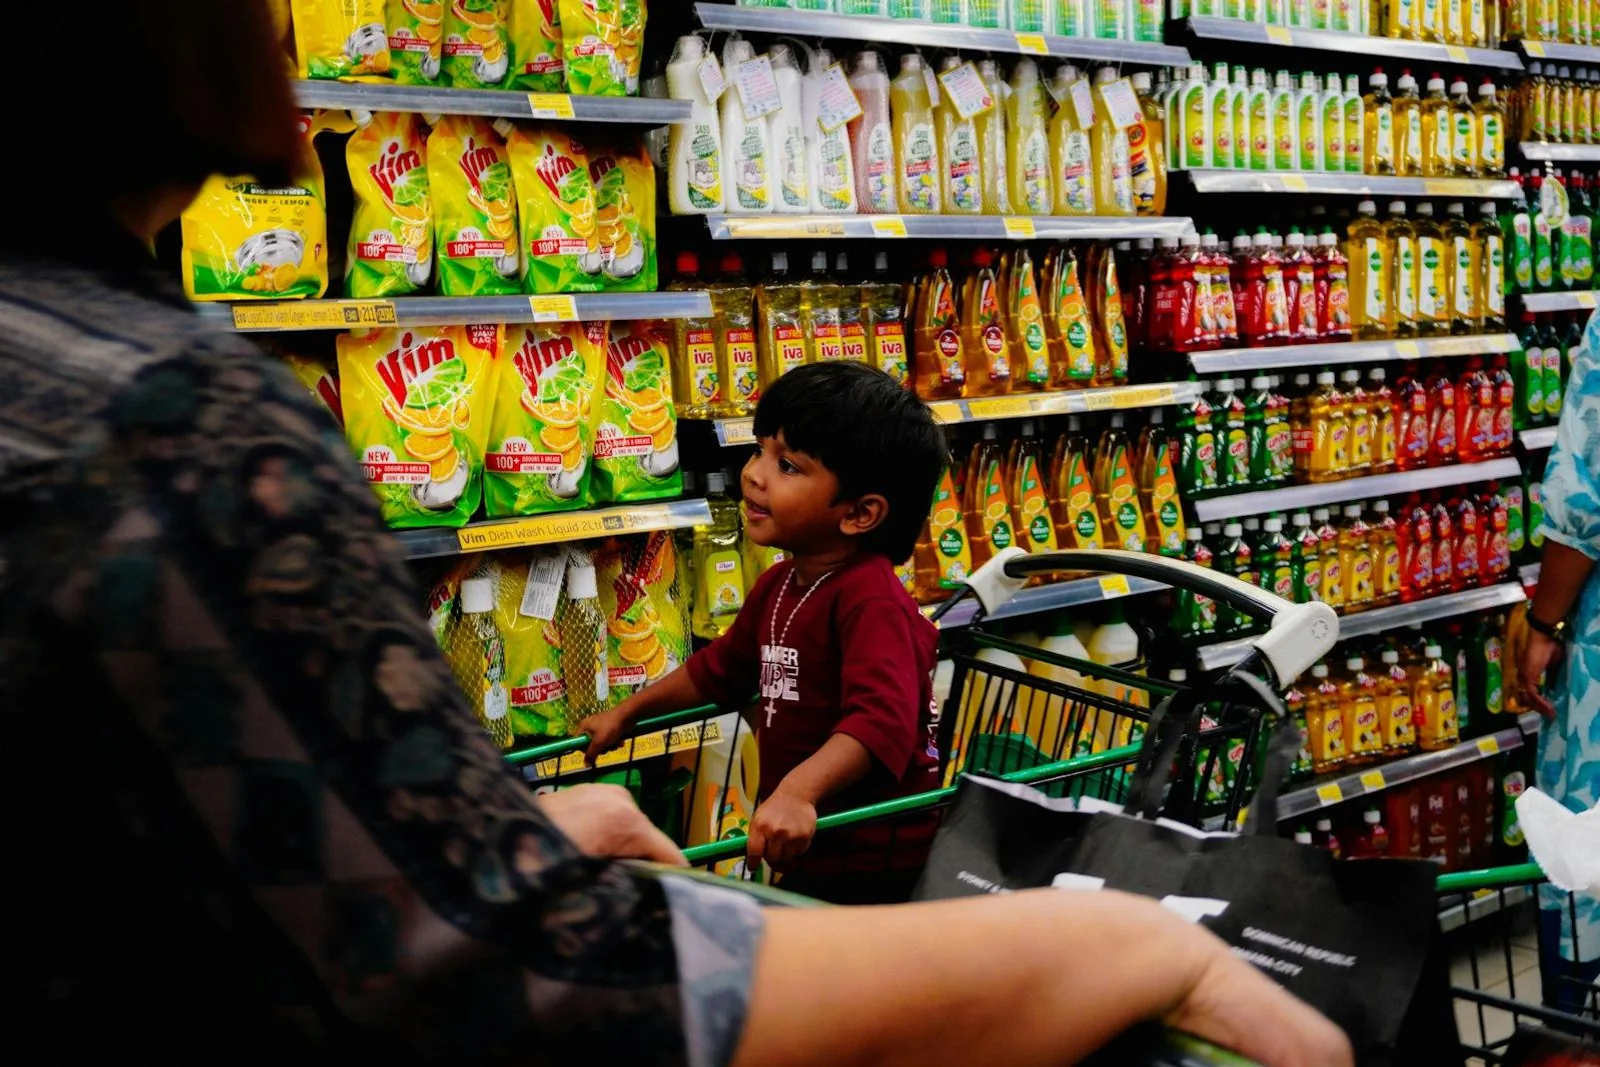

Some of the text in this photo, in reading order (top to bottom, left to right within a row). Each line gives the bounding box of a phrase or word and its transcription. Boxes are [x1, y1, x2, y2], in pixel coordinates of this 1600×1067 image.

[368, 141, 421, 205] Vim
[459, 137, 499, 200] Vim
[536, 144, 577, 199] Vim
[373, 234, 392, 243] NEW
[462, 231, 479, 240] NEW
[546, 229, 563, 239] NEW
[362, 244, 385, 256] 100+
[453, 243, 474, 254] 100+
[537, 240, 560, 253] 100+
[783, 344, 804, 359] iva
[821, 341, 840, 356] iva
[842, 341, 864, 356] iva
[881, 340, 903, 354] iva
[693, 349, 714, 364] iva
[733, 347, 753, 363] iva
[376, 332, 456, 410] Vim
[512, 329, 575, 404] Vim
[505, 442, 527, 452] NEW
[367, 451, 391, 462] NEW
[495, 457, 520, 469] 100+
[461, 533, 486, 545] Vim
[489, 529, 513, 542] Dish
[515, 526, 546, 539] Wash
[547, 522, 580, 537] Liquid
[532, 673, 551, 684] NEW
[521, 687, 547, 701] 100+
[1241, 926, 1358, 967] DOMINICAN REPUBLIC
[1273, 960, 1304, 977] CITY
